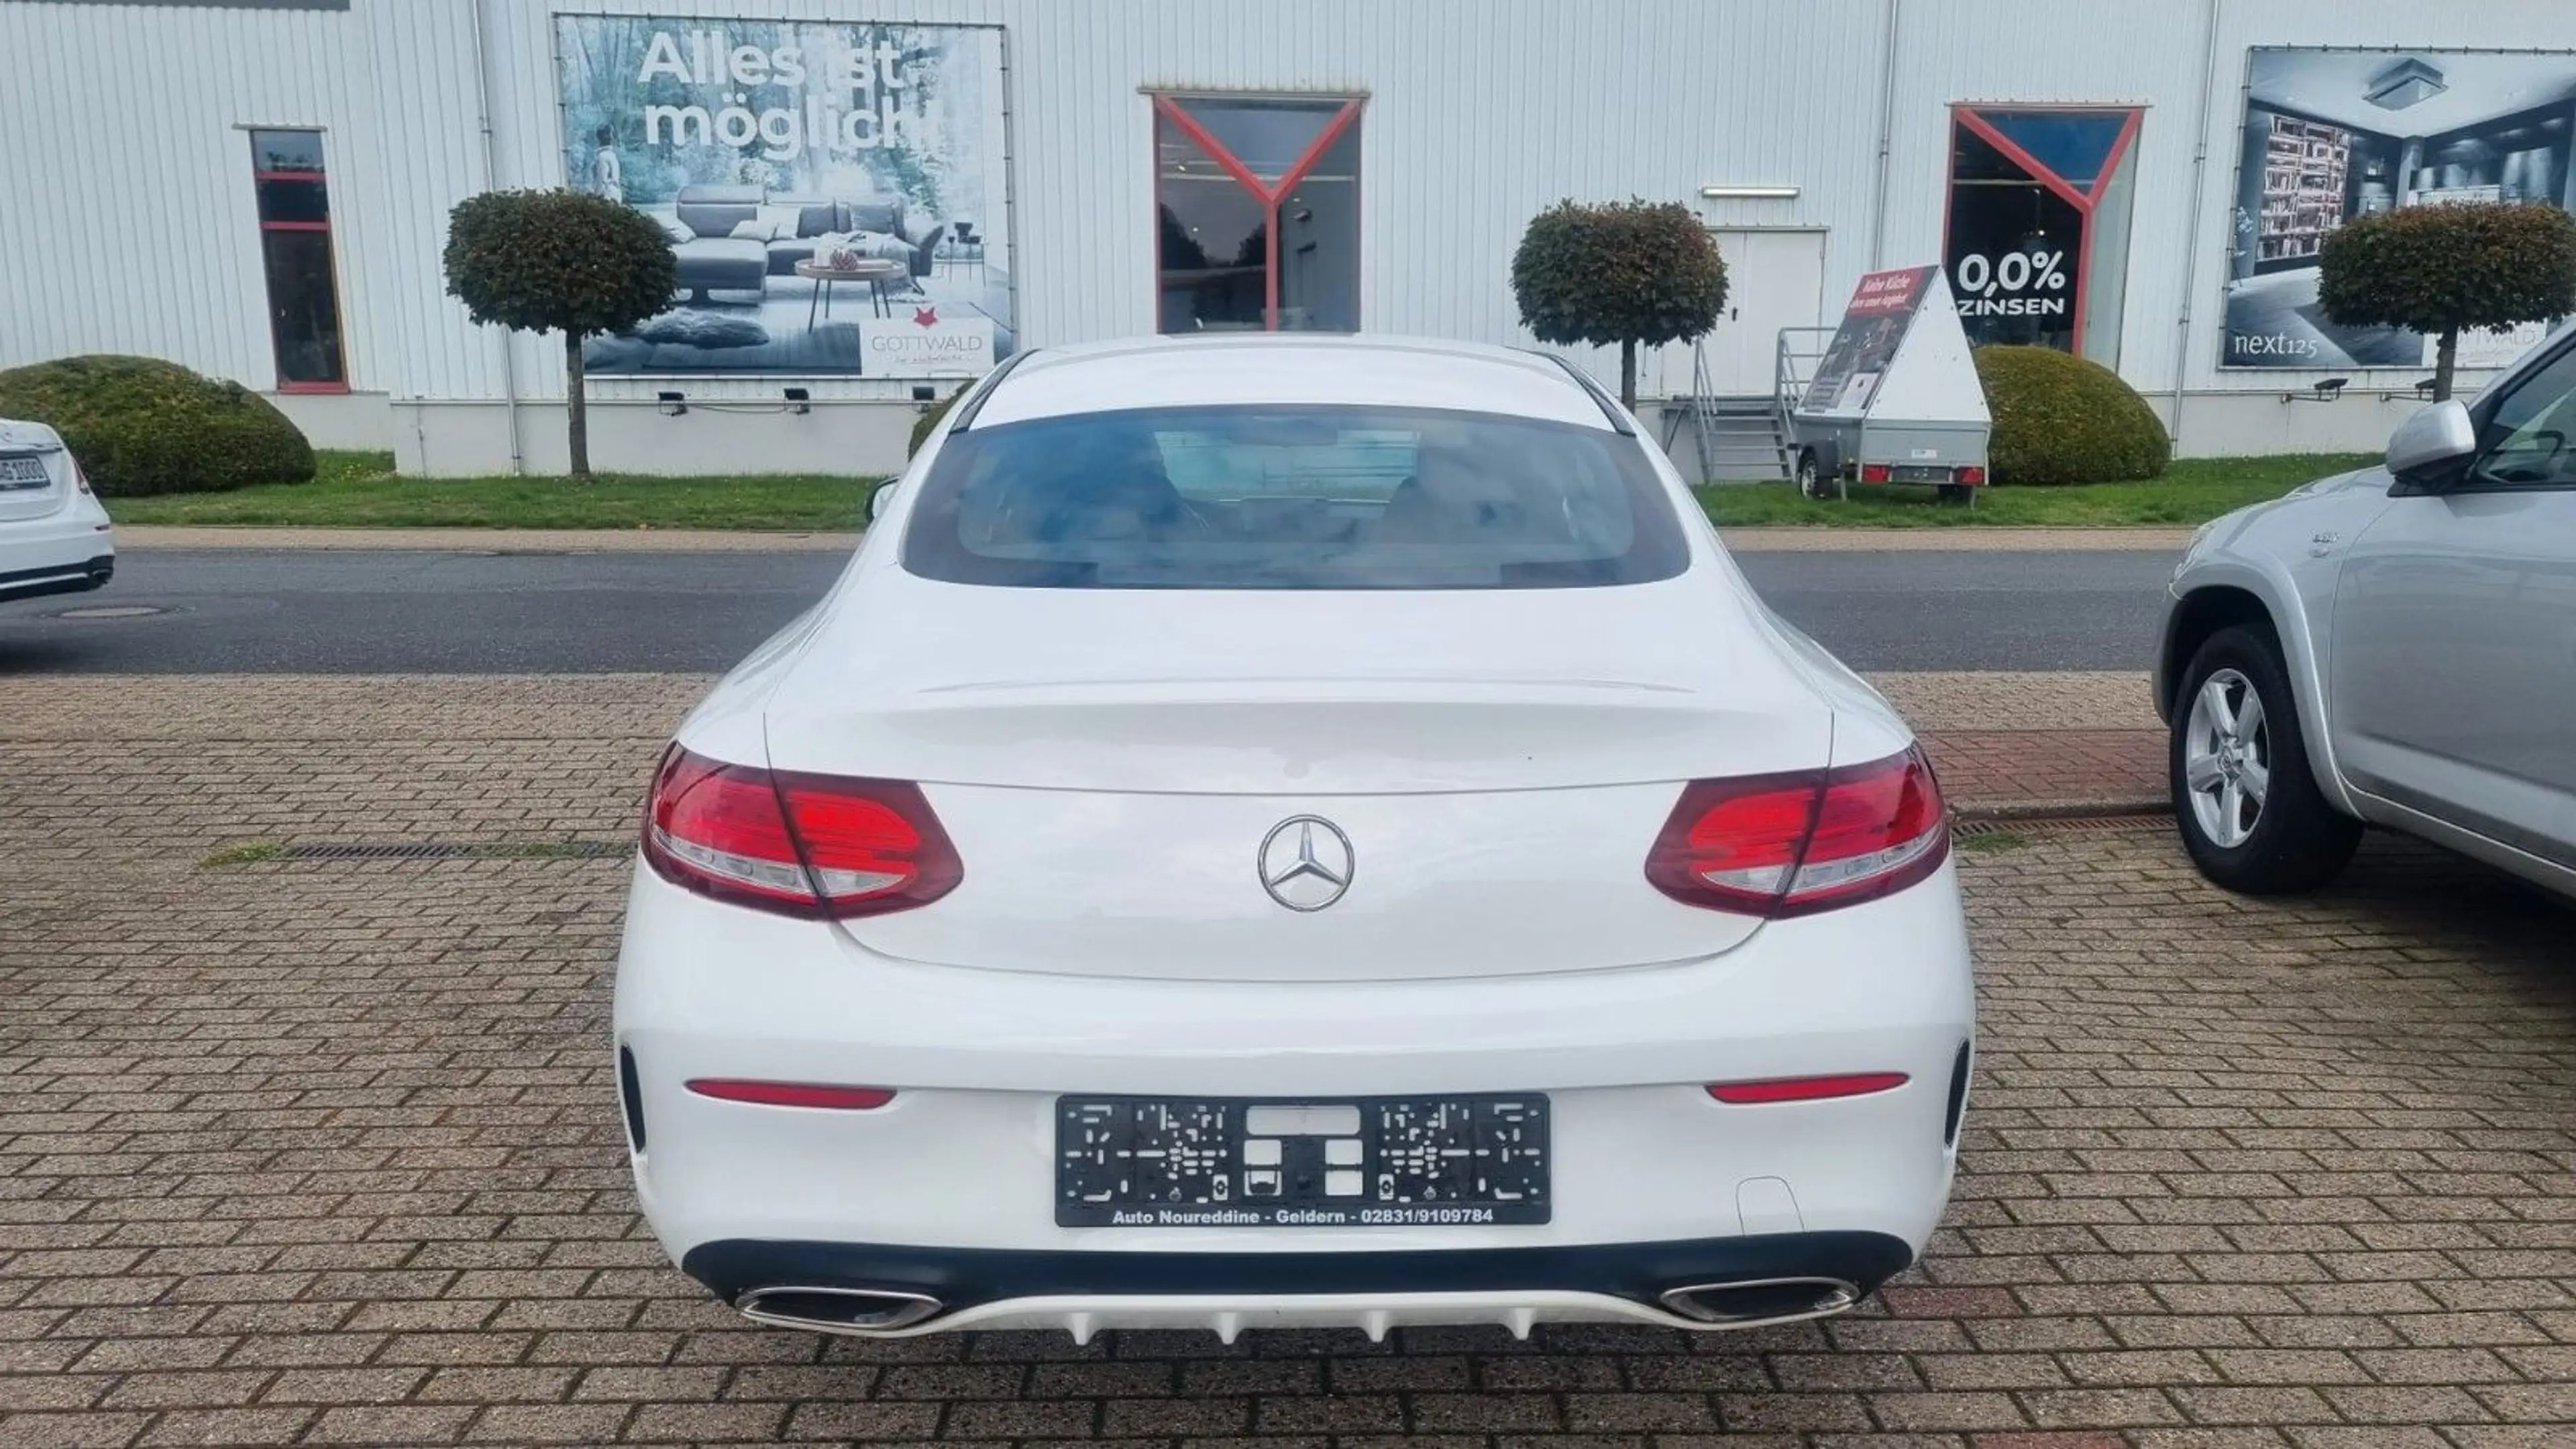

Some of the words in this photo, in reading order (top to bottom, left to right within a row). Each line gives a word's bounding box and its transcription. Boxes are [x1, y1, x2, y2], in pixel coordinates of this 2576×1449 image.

[638, 30, 806, 86] Alles
[1958, 250, 2065, 297] 0,0%
[1957, 297, 2065, 317] ZINSEN
[871, 335, 983, 352] GOTTWALD
[2235, 331, 2318, 358] next125
[1112, 1210, 1154, 1224] Auto
[1159, 1210, 1260, 1224] Noureddine
[1276, 1210, 1346, 1224] Geldern
[1360, 1209, 1494, 1224] 02831/9109784
